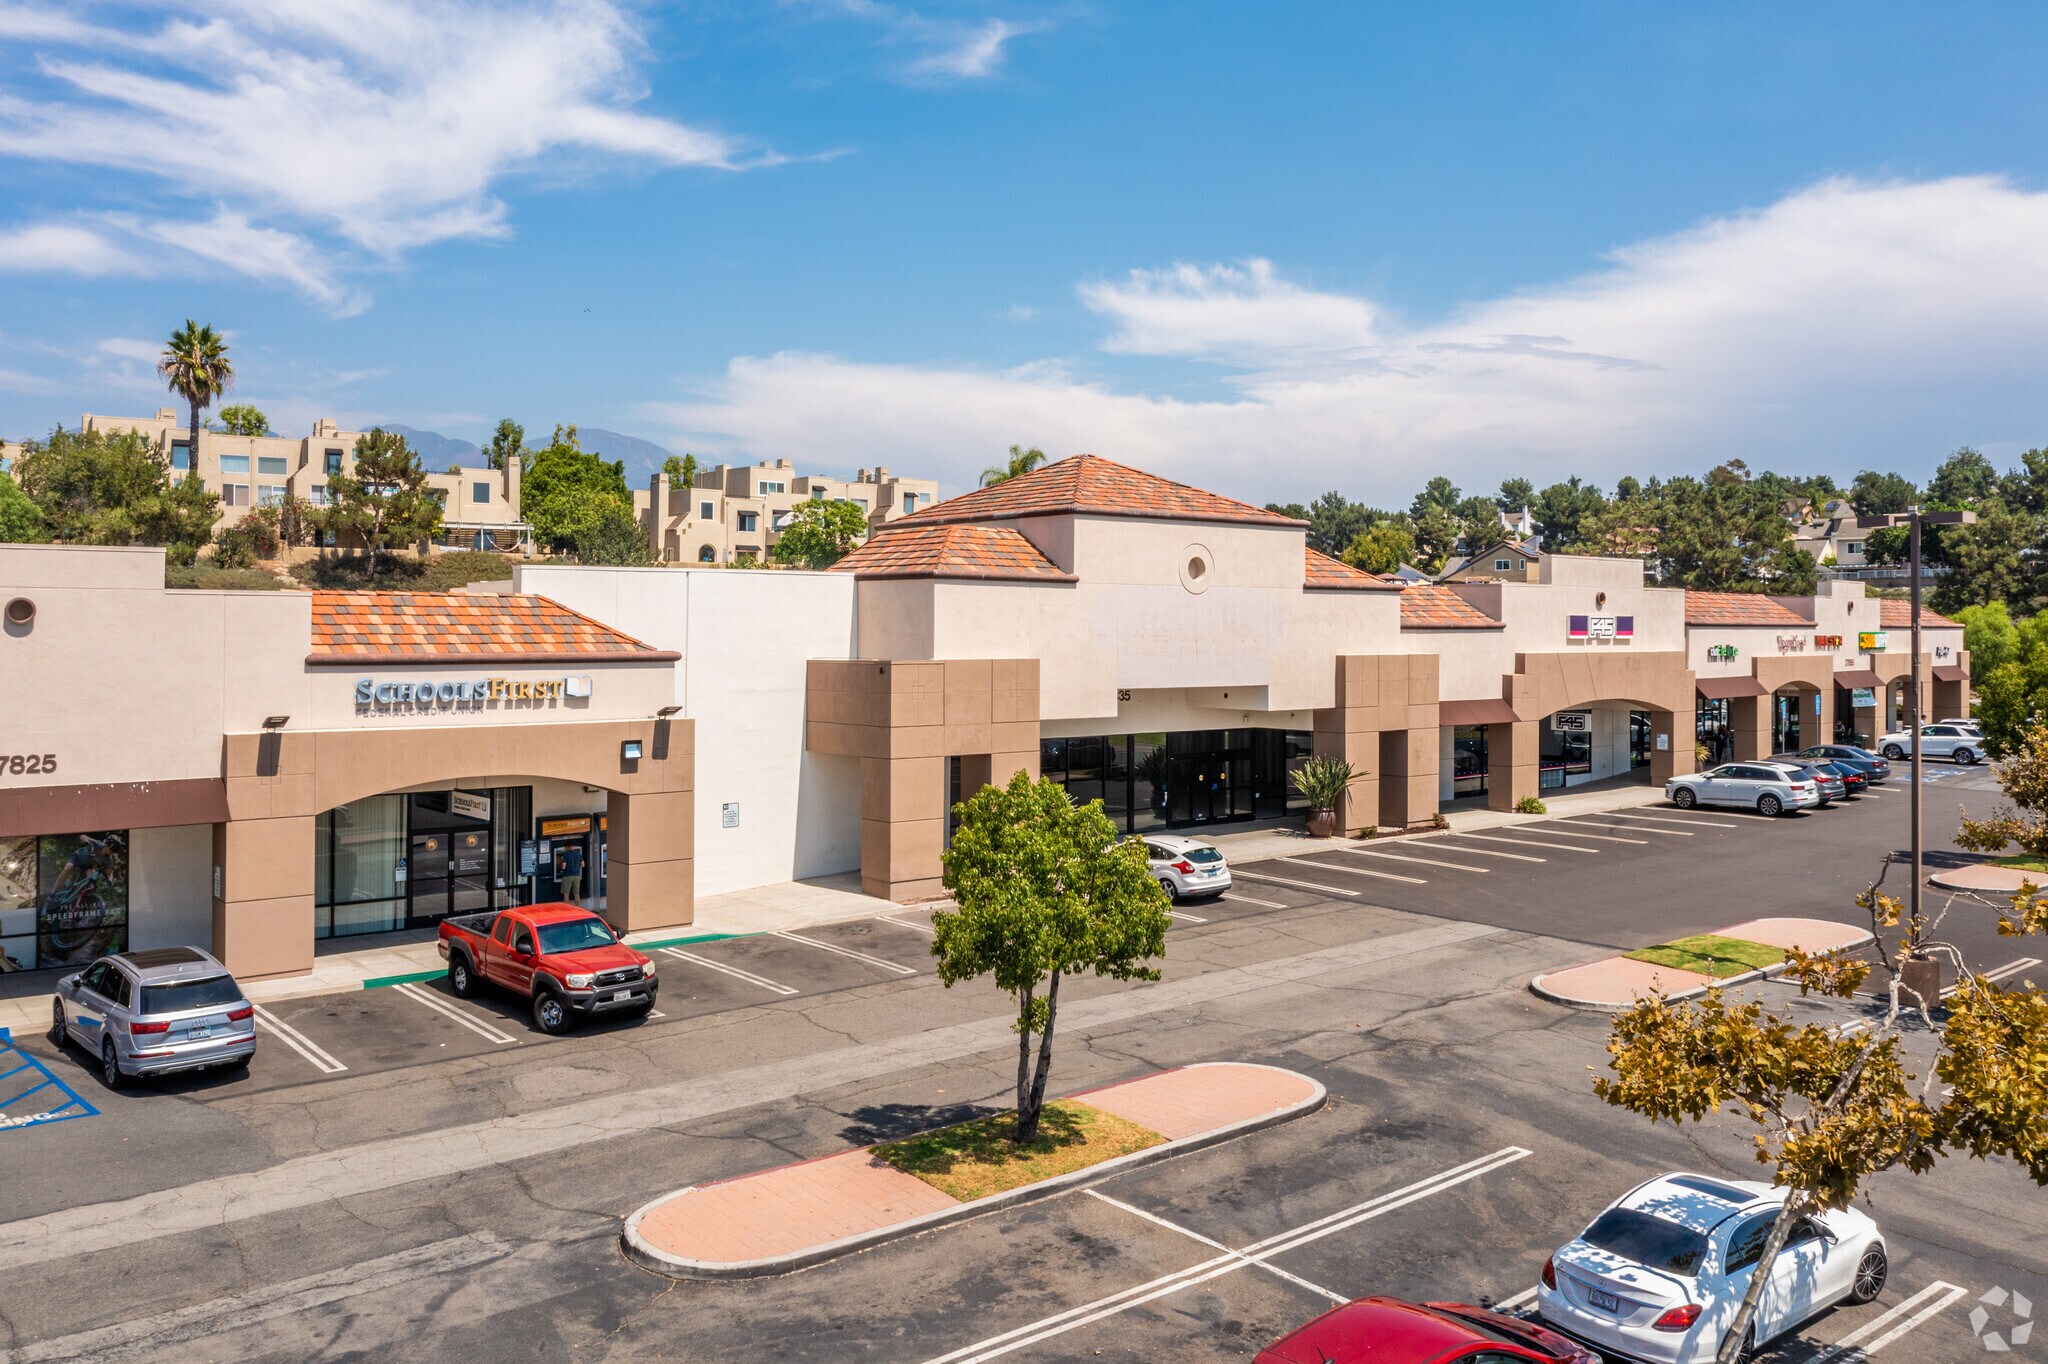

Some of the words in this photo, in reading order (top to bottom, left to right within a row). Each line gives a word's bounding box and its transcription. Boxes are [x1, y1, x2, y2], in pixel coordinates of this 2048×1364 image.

[1590, 617, 1614, 637] F45
[1118, 690, 1131, 702] 35
[356, 707, 406, 718] FEDERAL
[408, 706, 448, 716] CREDIT
[451, 704, 484, 715] UNION
[1557, 714, 1585, 730] F45
[47, 909, 101, 920] SPEEDFRAME
